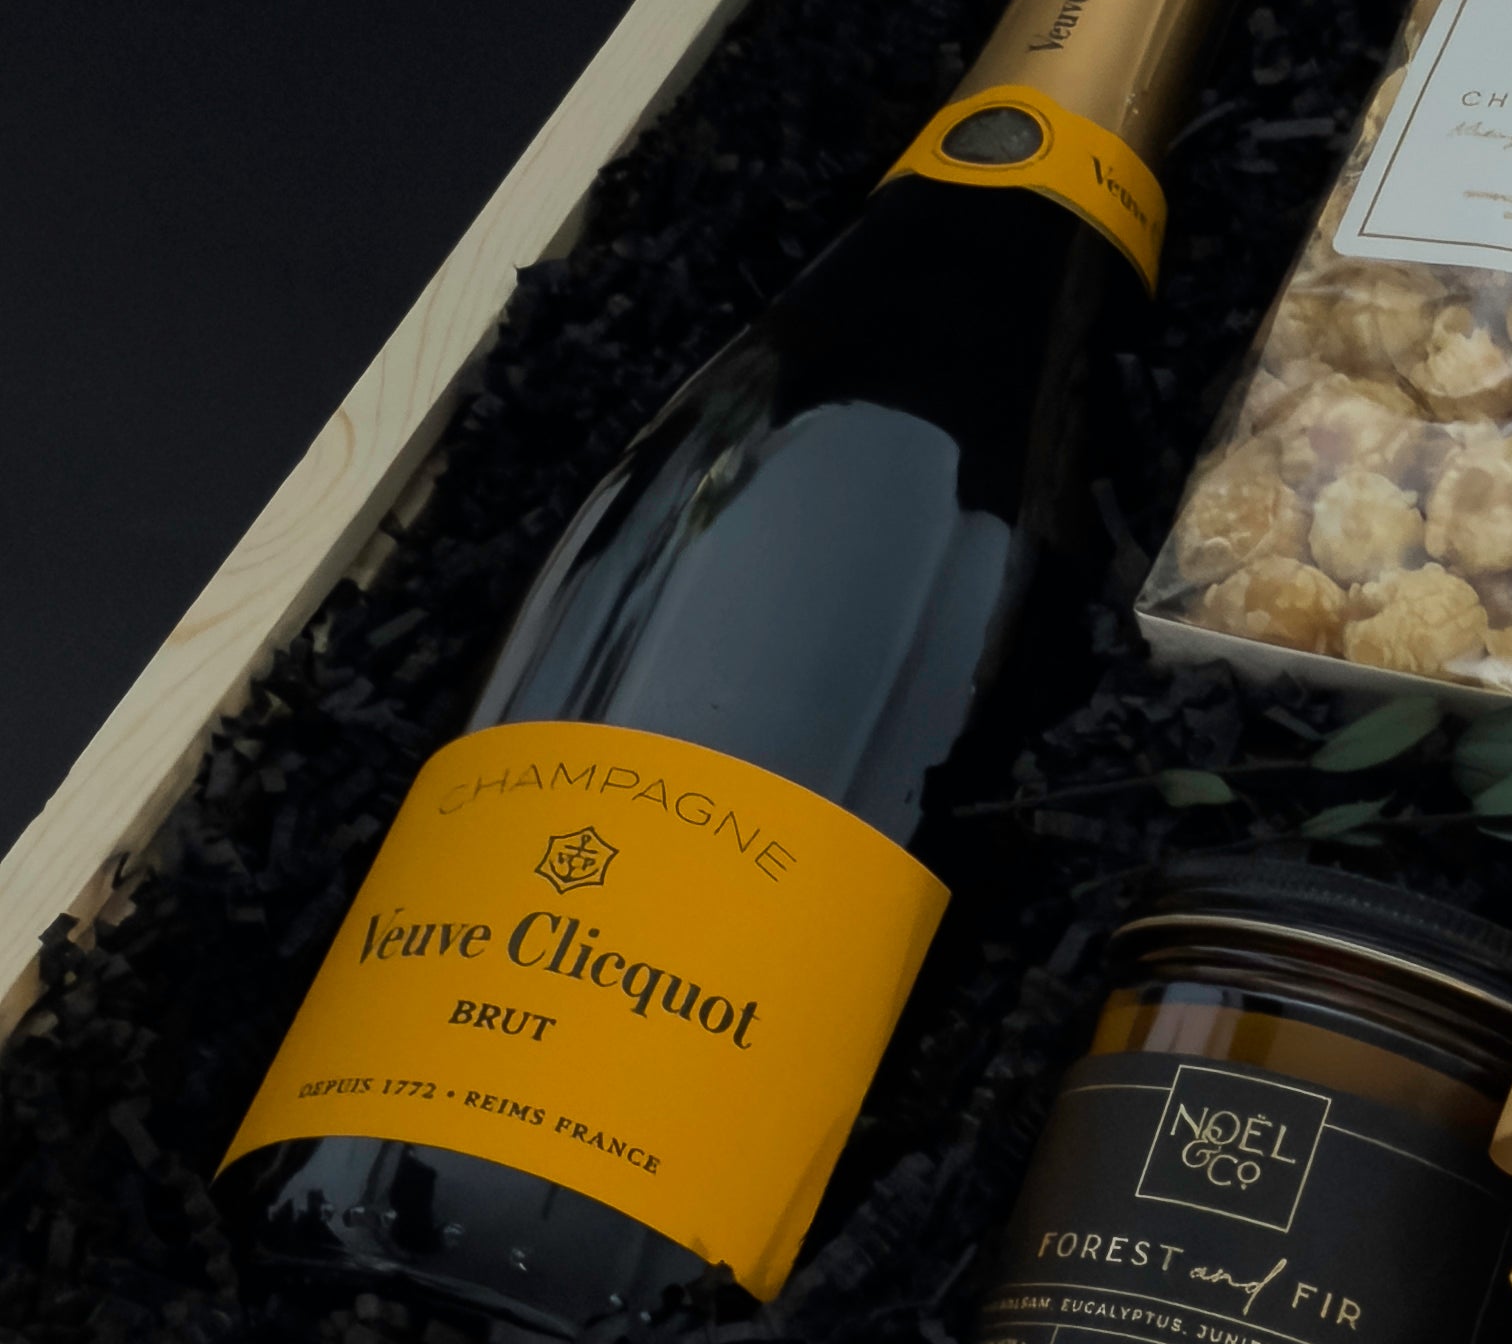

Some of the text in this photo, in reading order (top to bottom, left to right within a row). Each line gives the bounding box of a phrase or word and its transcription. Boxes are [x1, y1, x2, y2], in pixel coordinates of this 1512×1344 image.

[437, 760, 798, 884] CHAMPAGNE
[358, 906, 762, 1052] Veuve Clicquot
[447, 998, 557, 1042] BRUT
[298, 1076, 663, 1177] DEPUIS 1772 REIMS FRANCE
[1169, 1102, 1296, 1165] NOËL
[1037, 1231, 1363, 1331] FOREST and FIR
